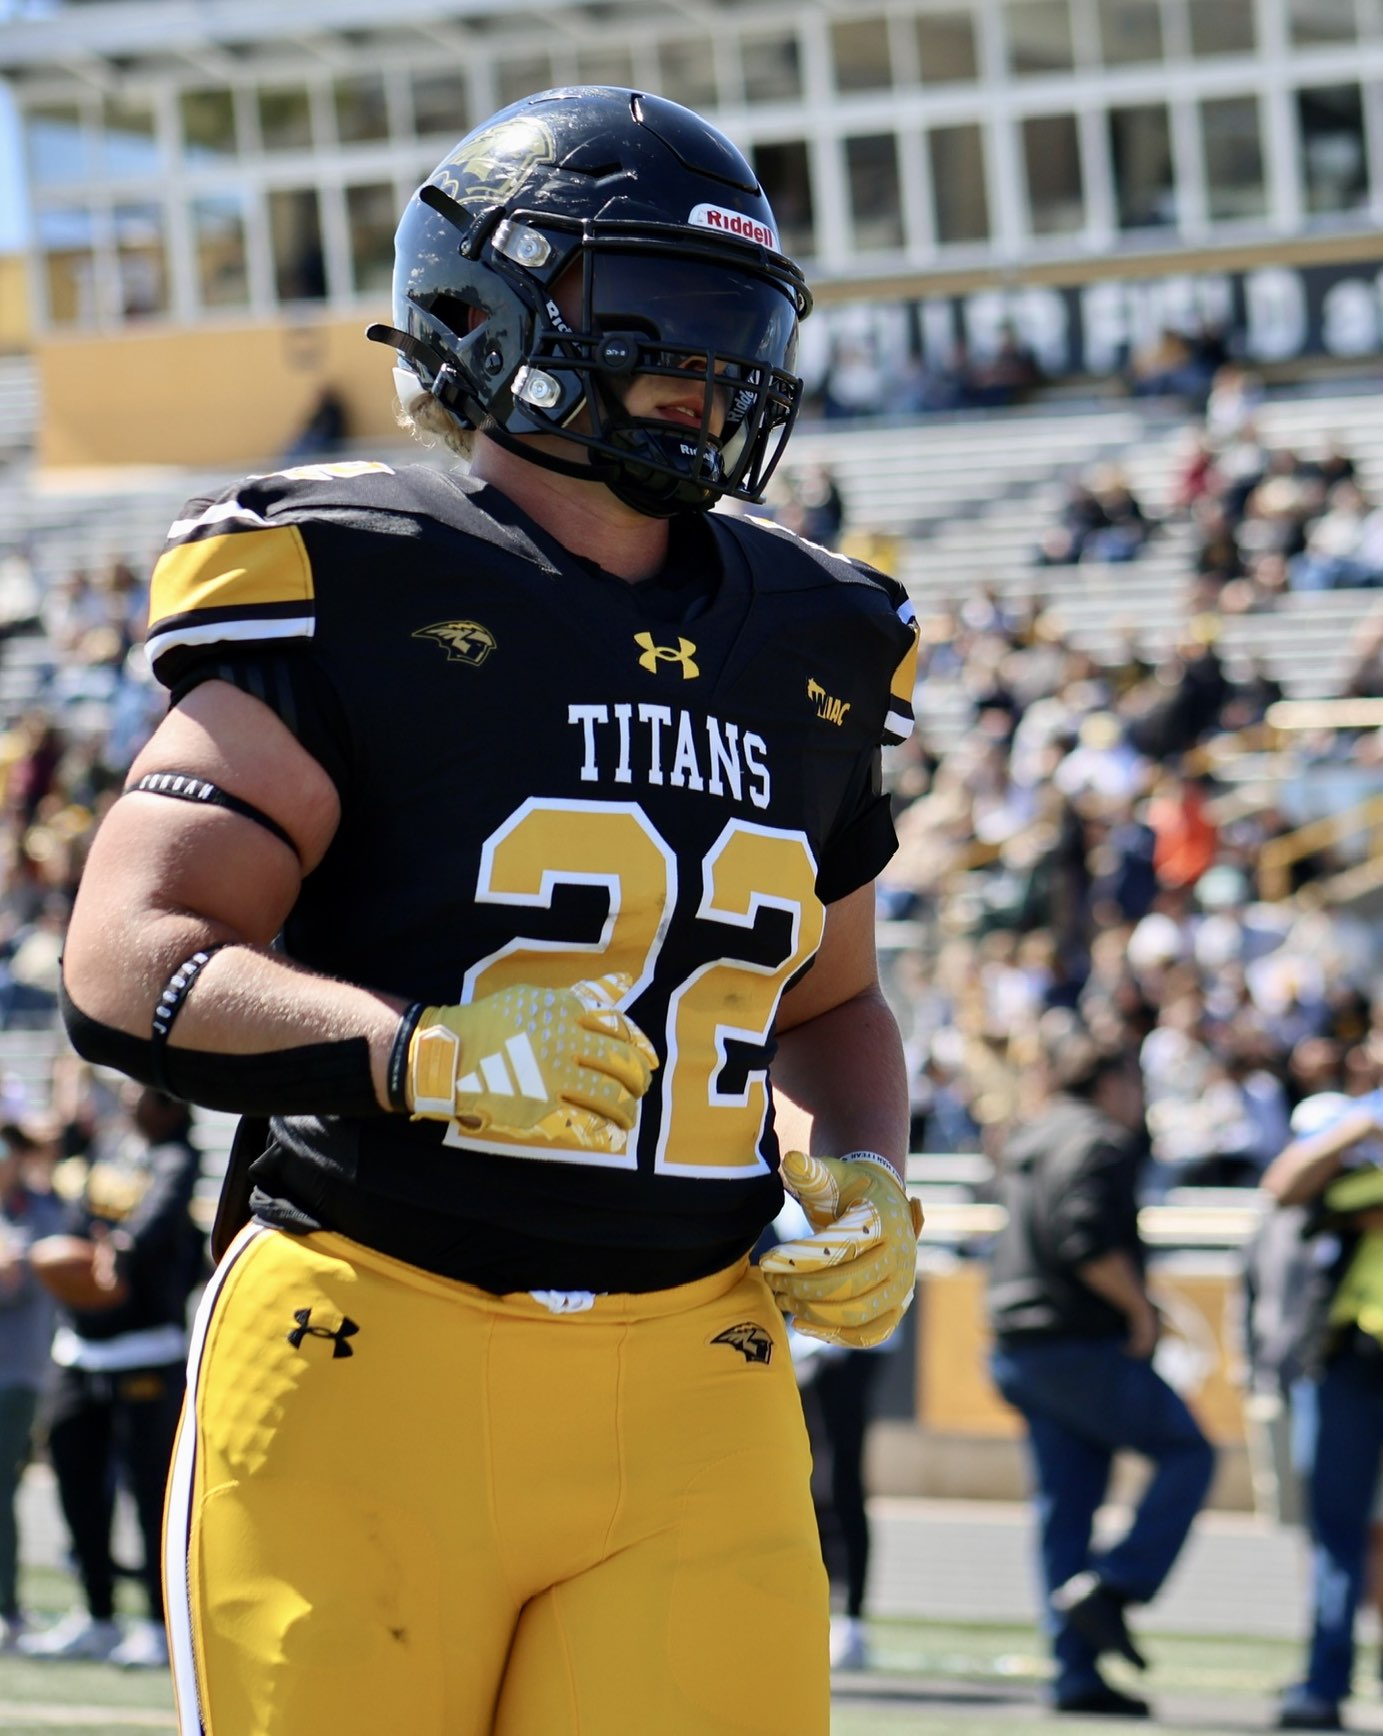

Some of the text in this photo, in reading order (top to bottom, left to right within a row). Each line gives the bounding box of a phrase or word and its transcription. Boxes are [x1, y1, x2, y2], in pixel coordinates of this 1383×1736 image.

[706, 209, 774, 249] Riddell
[567, 703, 771, 810] TITANS
[443, 796, 827, 1179] 22
